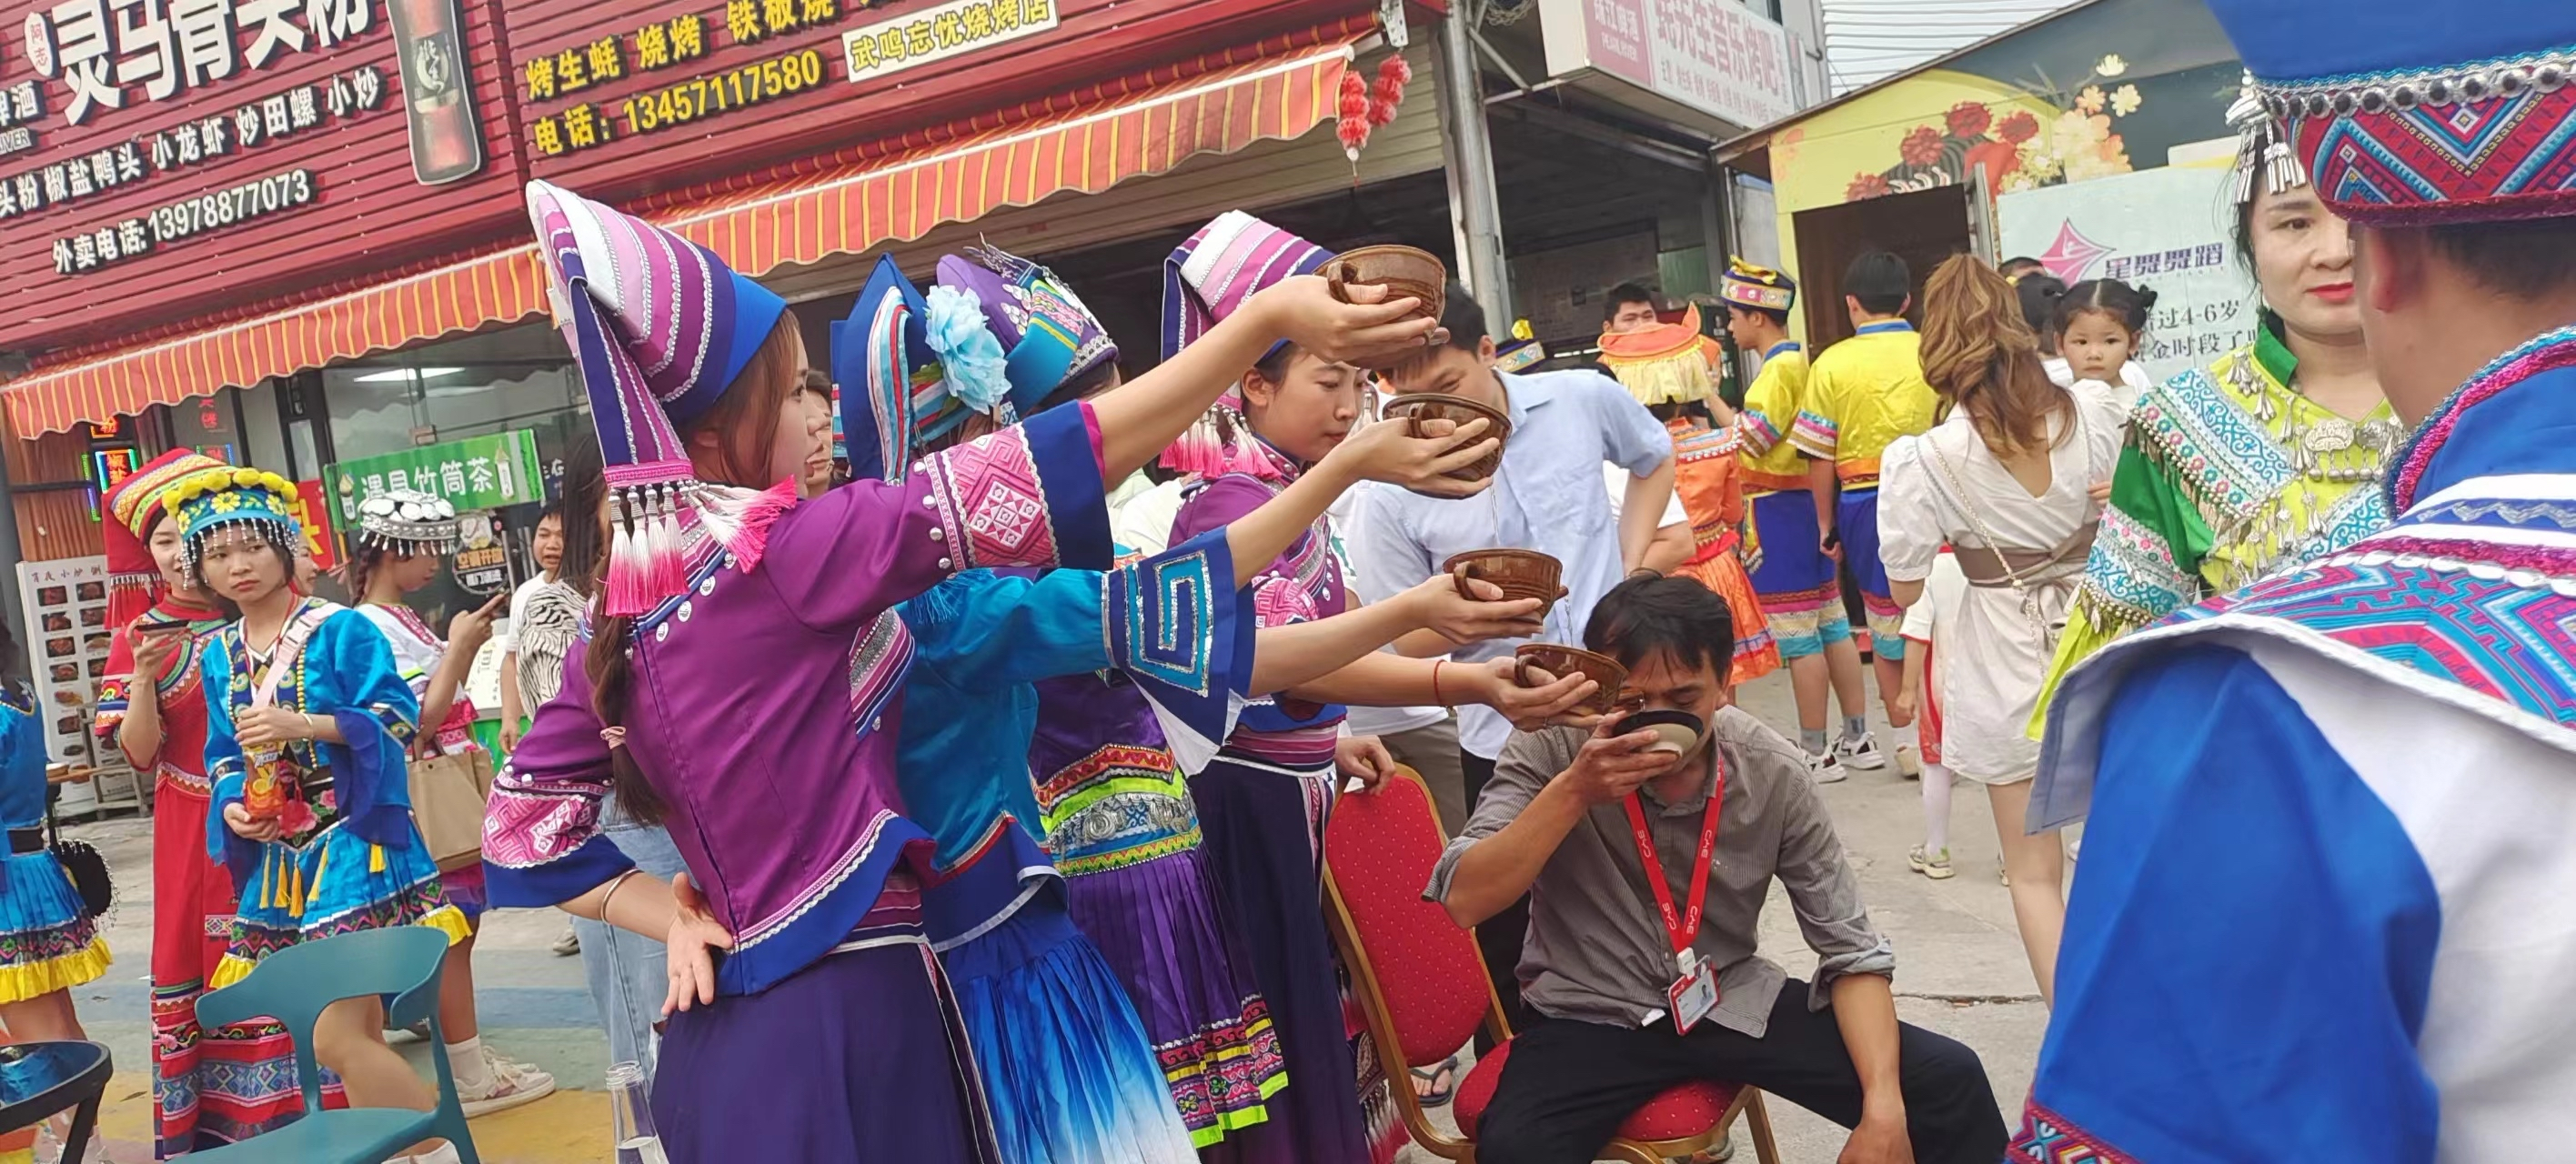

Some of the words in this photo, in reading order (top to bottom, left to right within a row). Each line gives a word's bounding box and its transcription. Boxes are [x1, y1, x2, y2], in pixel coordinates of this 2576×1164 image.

[525, 37, 619, 100] 烤生蚝
[637, 15, 701, 69] 烧烤
[850, 0, 1050, 72] 武鸣忘忧烧烤店
[44, 143, 142, 203] 椒盐鸭头
[151, 116, 226, 170] 小龙虾
[236, 86, 317, 146] 炒田螺
[327, 67, 379, 116] 小炒
